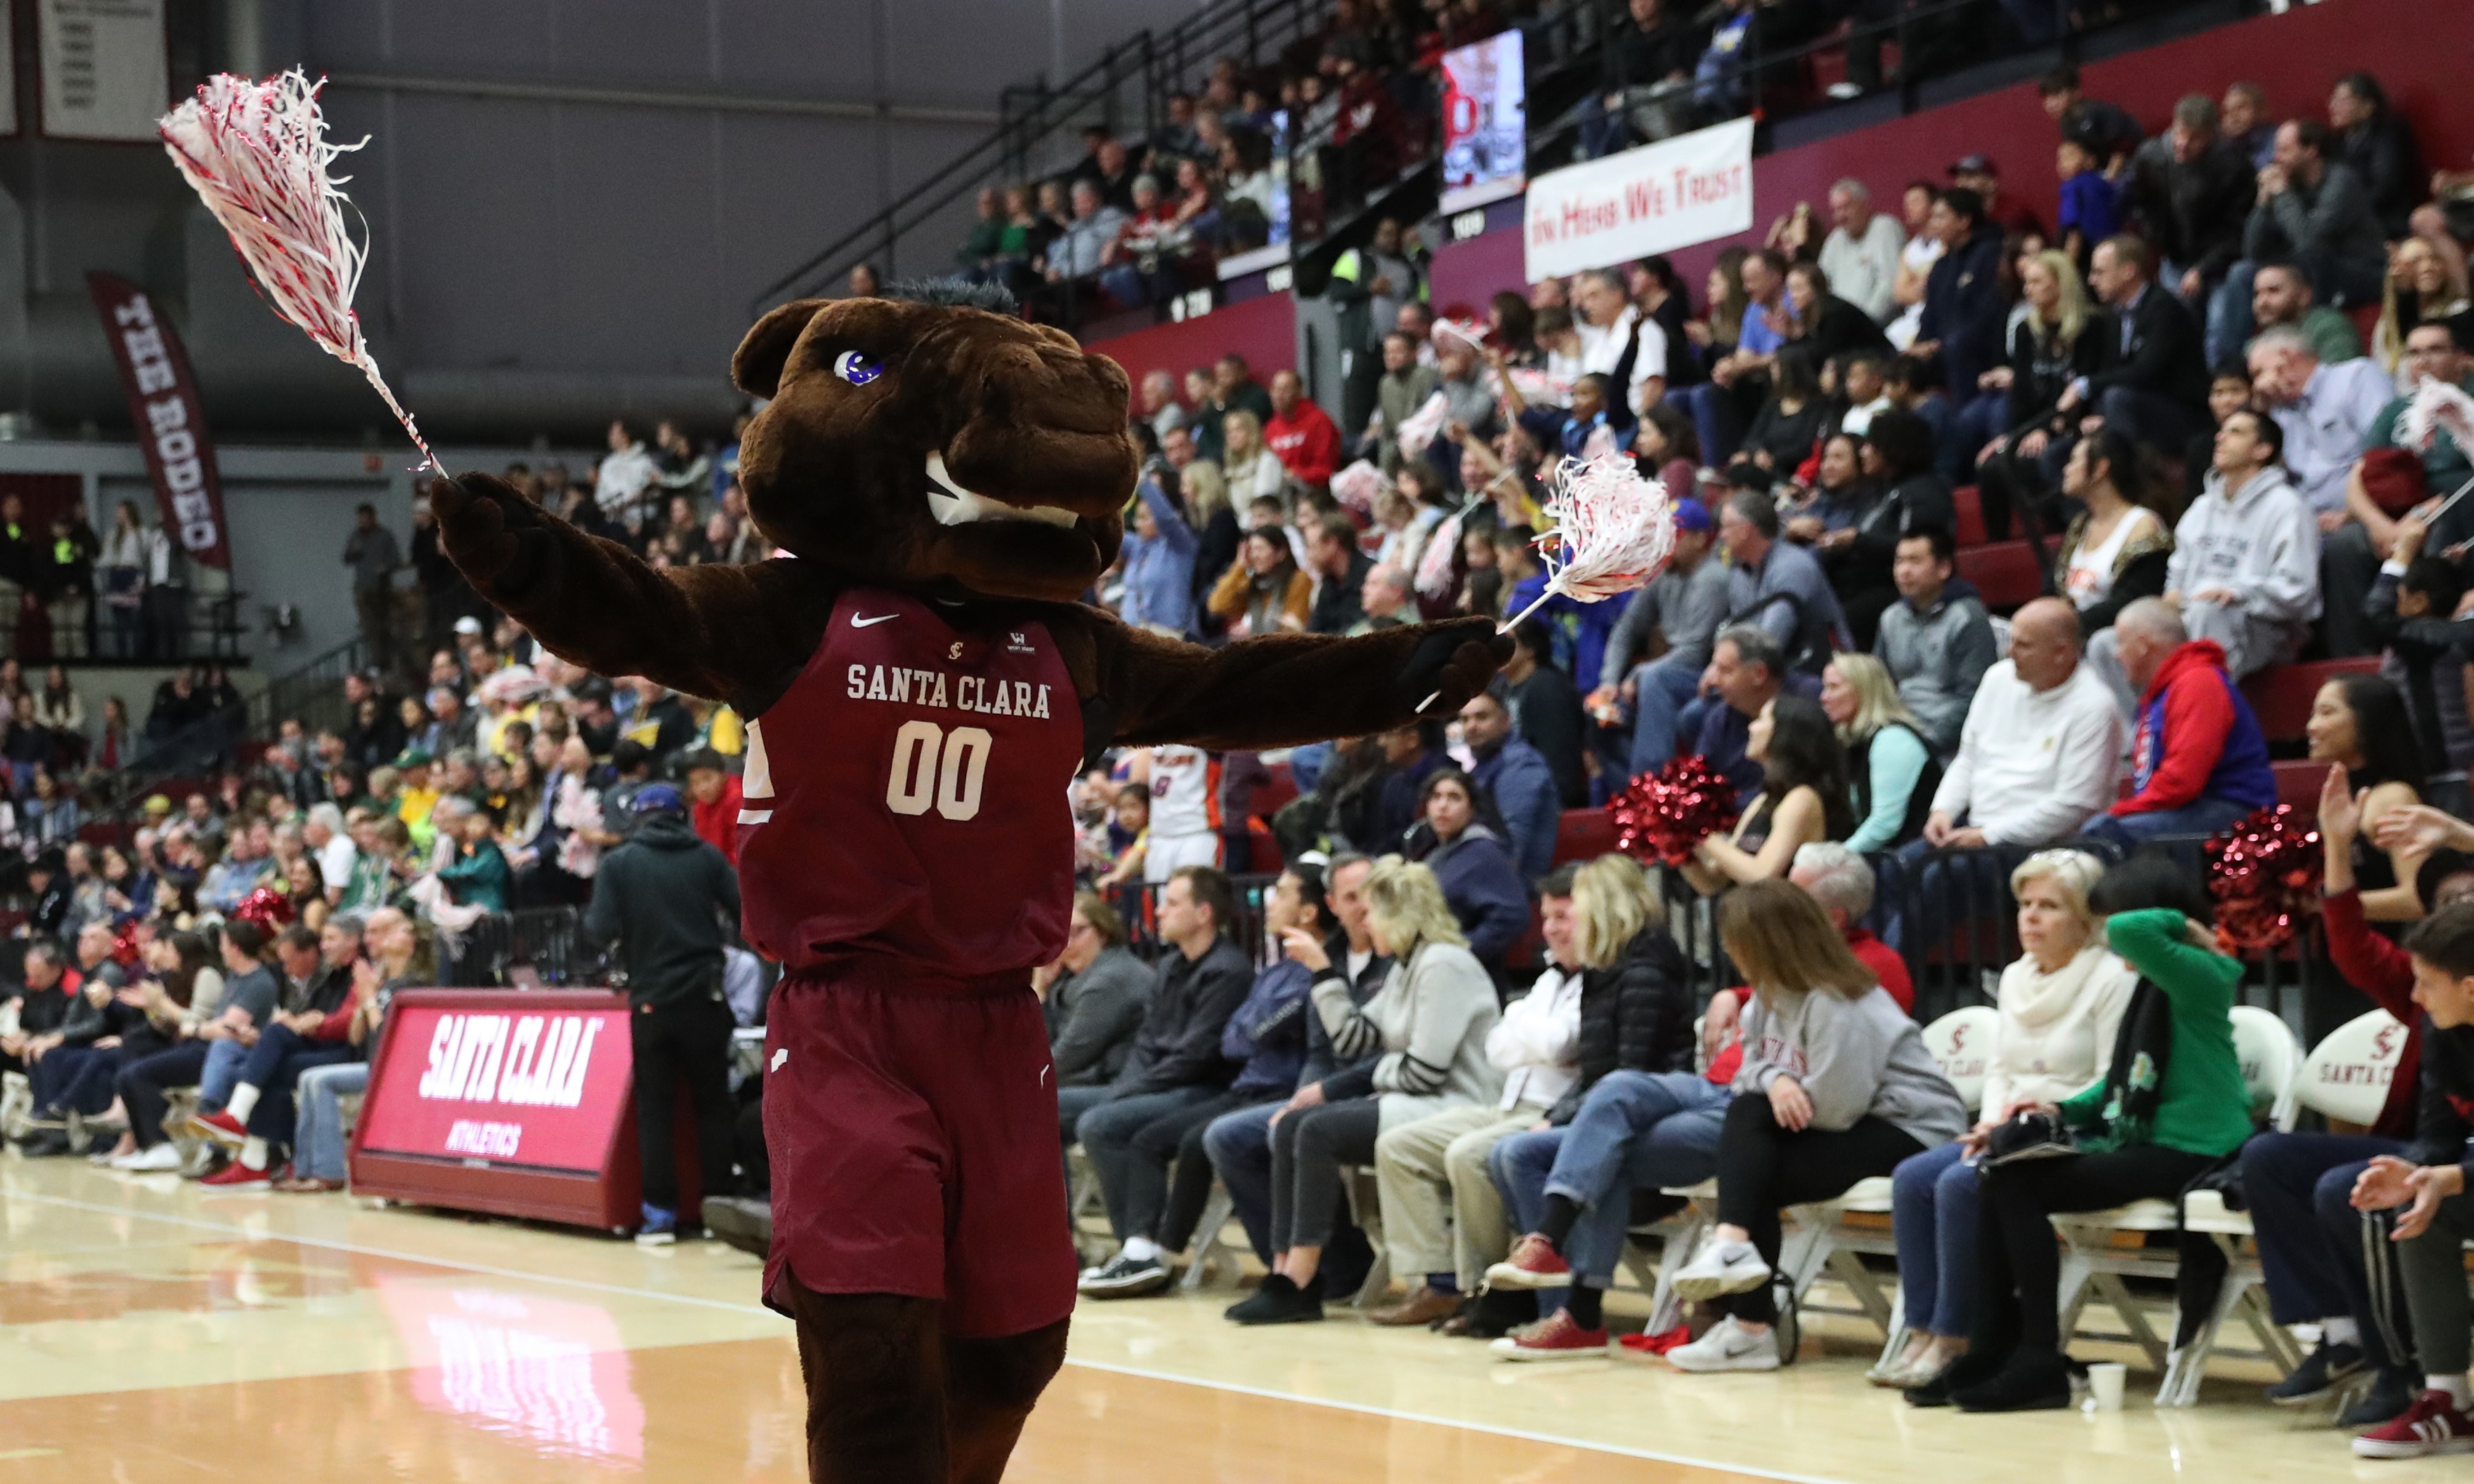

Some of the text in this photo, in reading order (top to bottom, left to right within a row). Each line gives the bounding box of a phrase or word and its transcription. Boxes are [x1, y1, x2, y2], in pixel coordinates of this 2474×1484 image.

[114, 292, 218, 552] THE RODEO
[848, 664, 1050, 719] SANTA CLARA
[886, 720, 993, 821] 00
[419, 1014, 599, 1108] SANTA CLARA
[2319, 1062, 2376, 1086] SANTA
[445, 1119, 523, 1157] ATHLETICS
